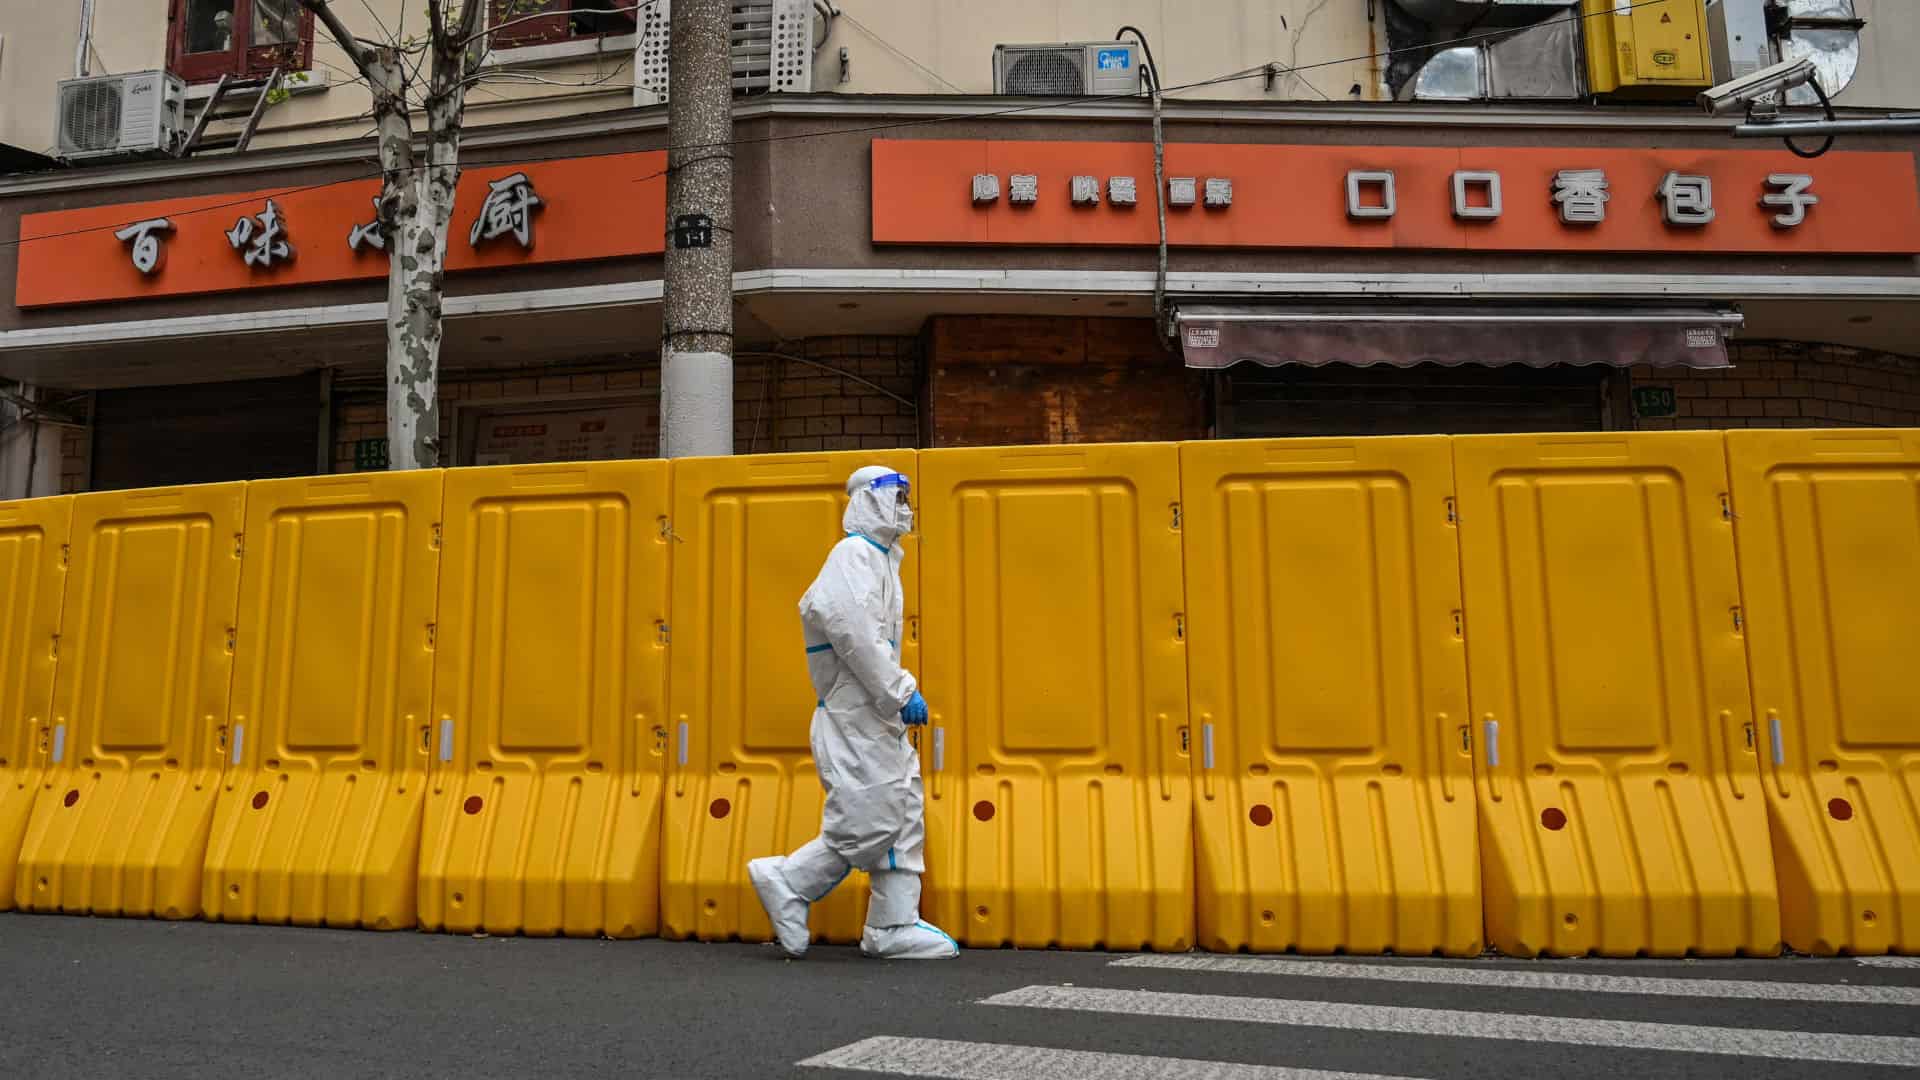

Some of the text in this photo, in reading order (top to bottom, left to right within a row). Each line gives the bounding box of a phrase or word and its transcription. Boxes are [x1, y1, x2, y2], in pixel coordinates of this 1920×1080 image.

[1345, 169, 1818, 228] 口口香包子
[1641, 391, 1670, 406] 150
